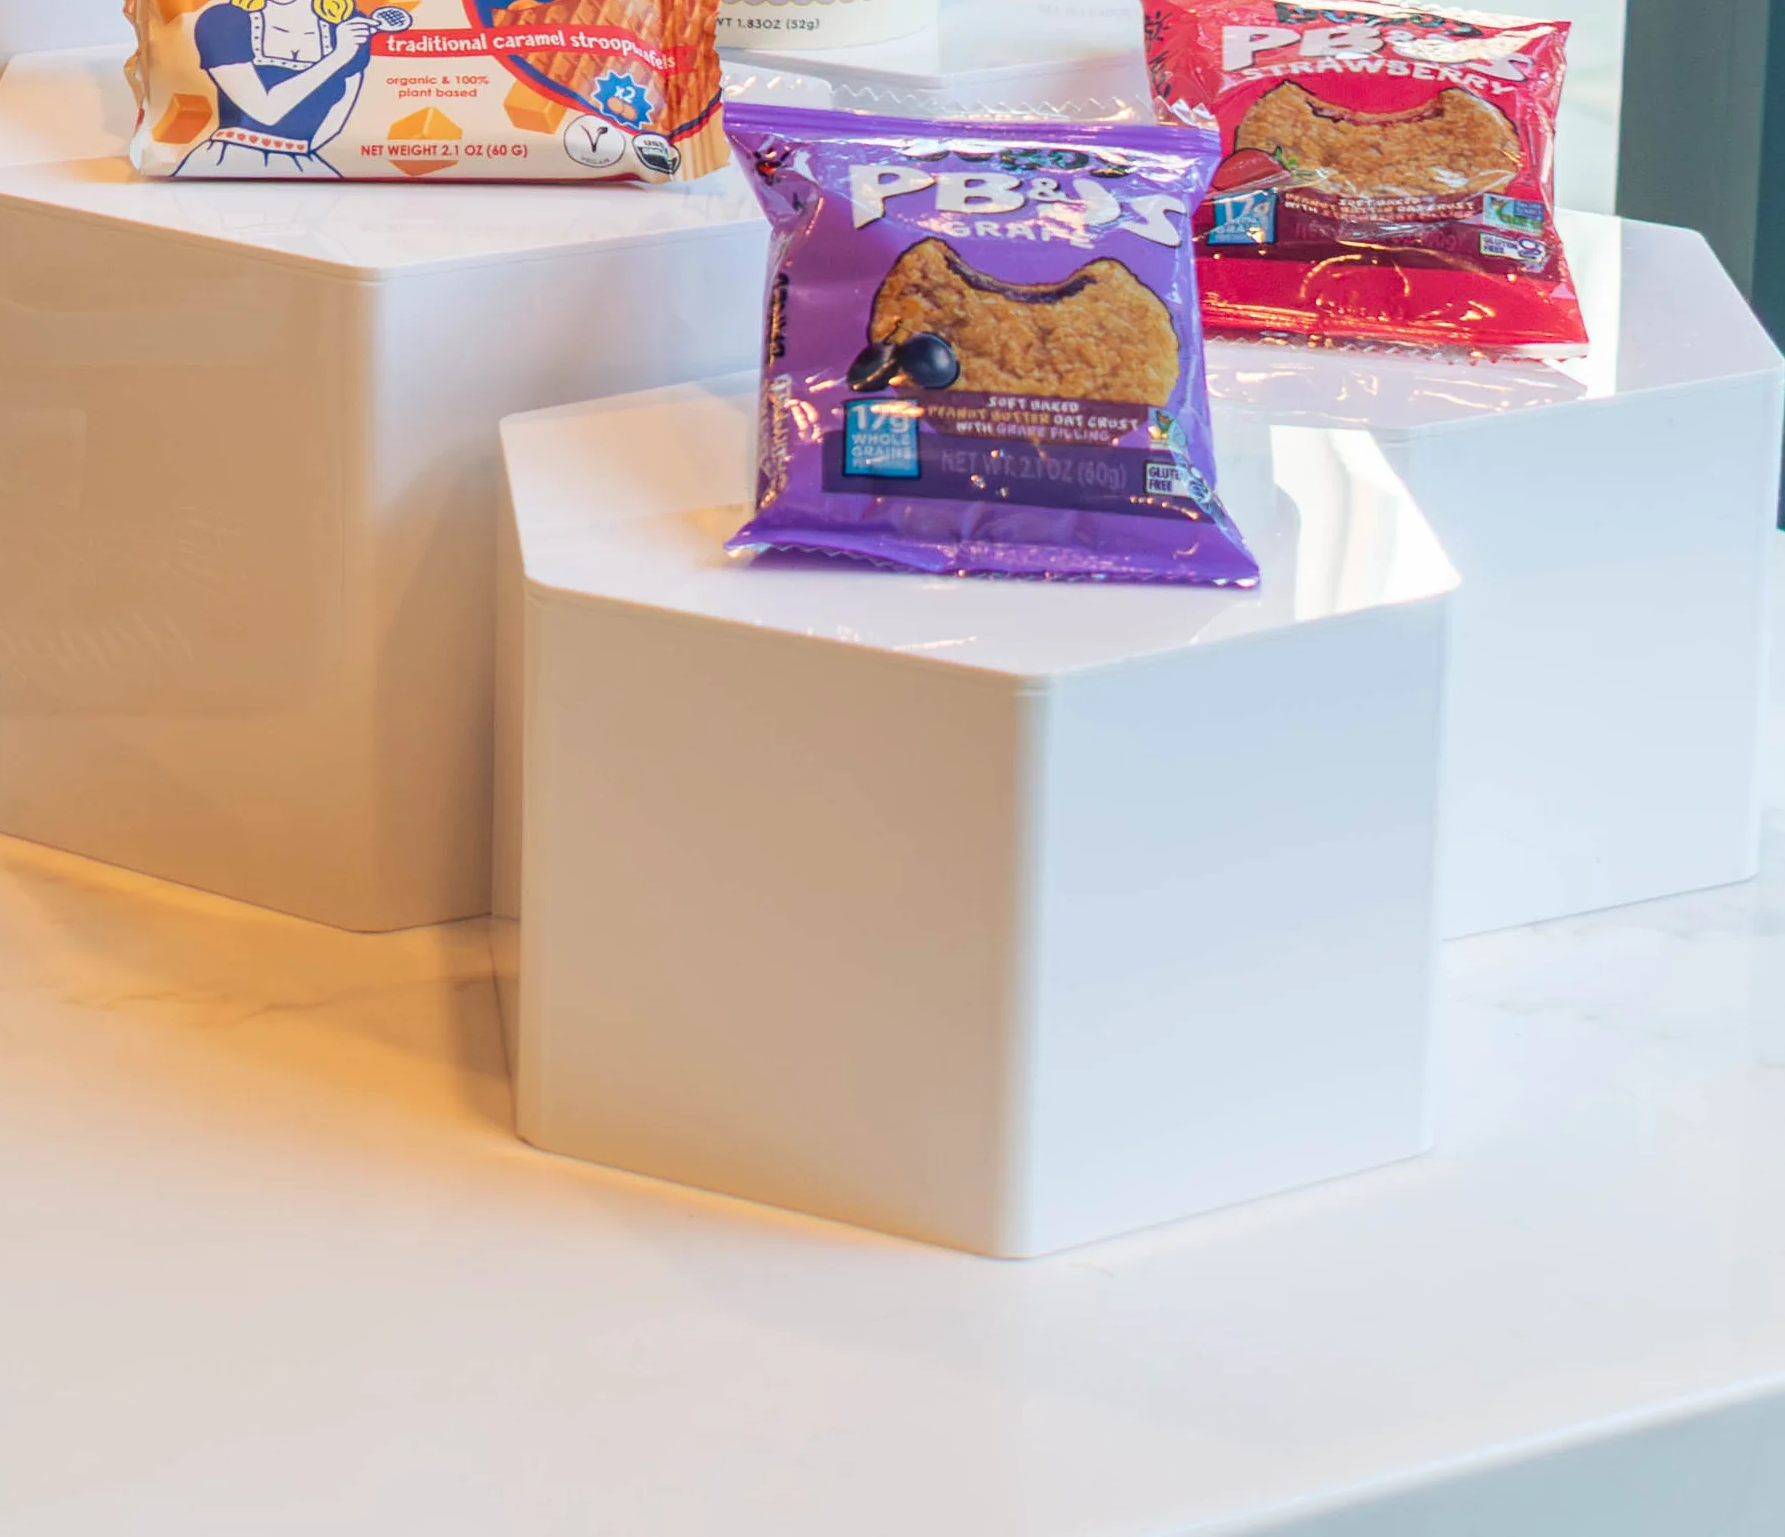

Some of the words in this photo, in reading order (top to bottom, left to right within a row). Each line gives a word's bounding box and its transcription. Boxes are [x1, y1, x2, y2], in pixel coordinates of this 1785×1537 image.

[786, 18, 820, 31] (52g)
[387, 32, 487, 52] traditional
[493, 31, 564, 49] caramel
[570, 35, 676, 69] stroopwafels
[386, 76, 437, 87] organic
[442, 76, 450, 85] &
[455, 75, 489, 85] 100%
[1242, 56, 1516, 95] STRAWBERRY
[398, 87, 432, 99] plant
[436, 87, 477, 98] based
[615, 84, 636, 102] x2
[361, 144, 383, 156] NET
[388, 144, 437, 157] WEIGHT
[441, 144, 459, 157] 2.1
[465, 144, 483, 157] OZ
[487, 144, 508, 158] (60
[512, 144, 528, 158] G)
[987, 397, 1025, 411] SOFT
[1031, 400, 1079, 413] BAKED
[956, 419, 991, 434] WITH
[1054, 413, 1084, 427] OAT
[1088, 416, 1139, 431] CRUST
[852, 434, 911, 446] WHOLE
[1148, 479, 1172, 492] FREE
